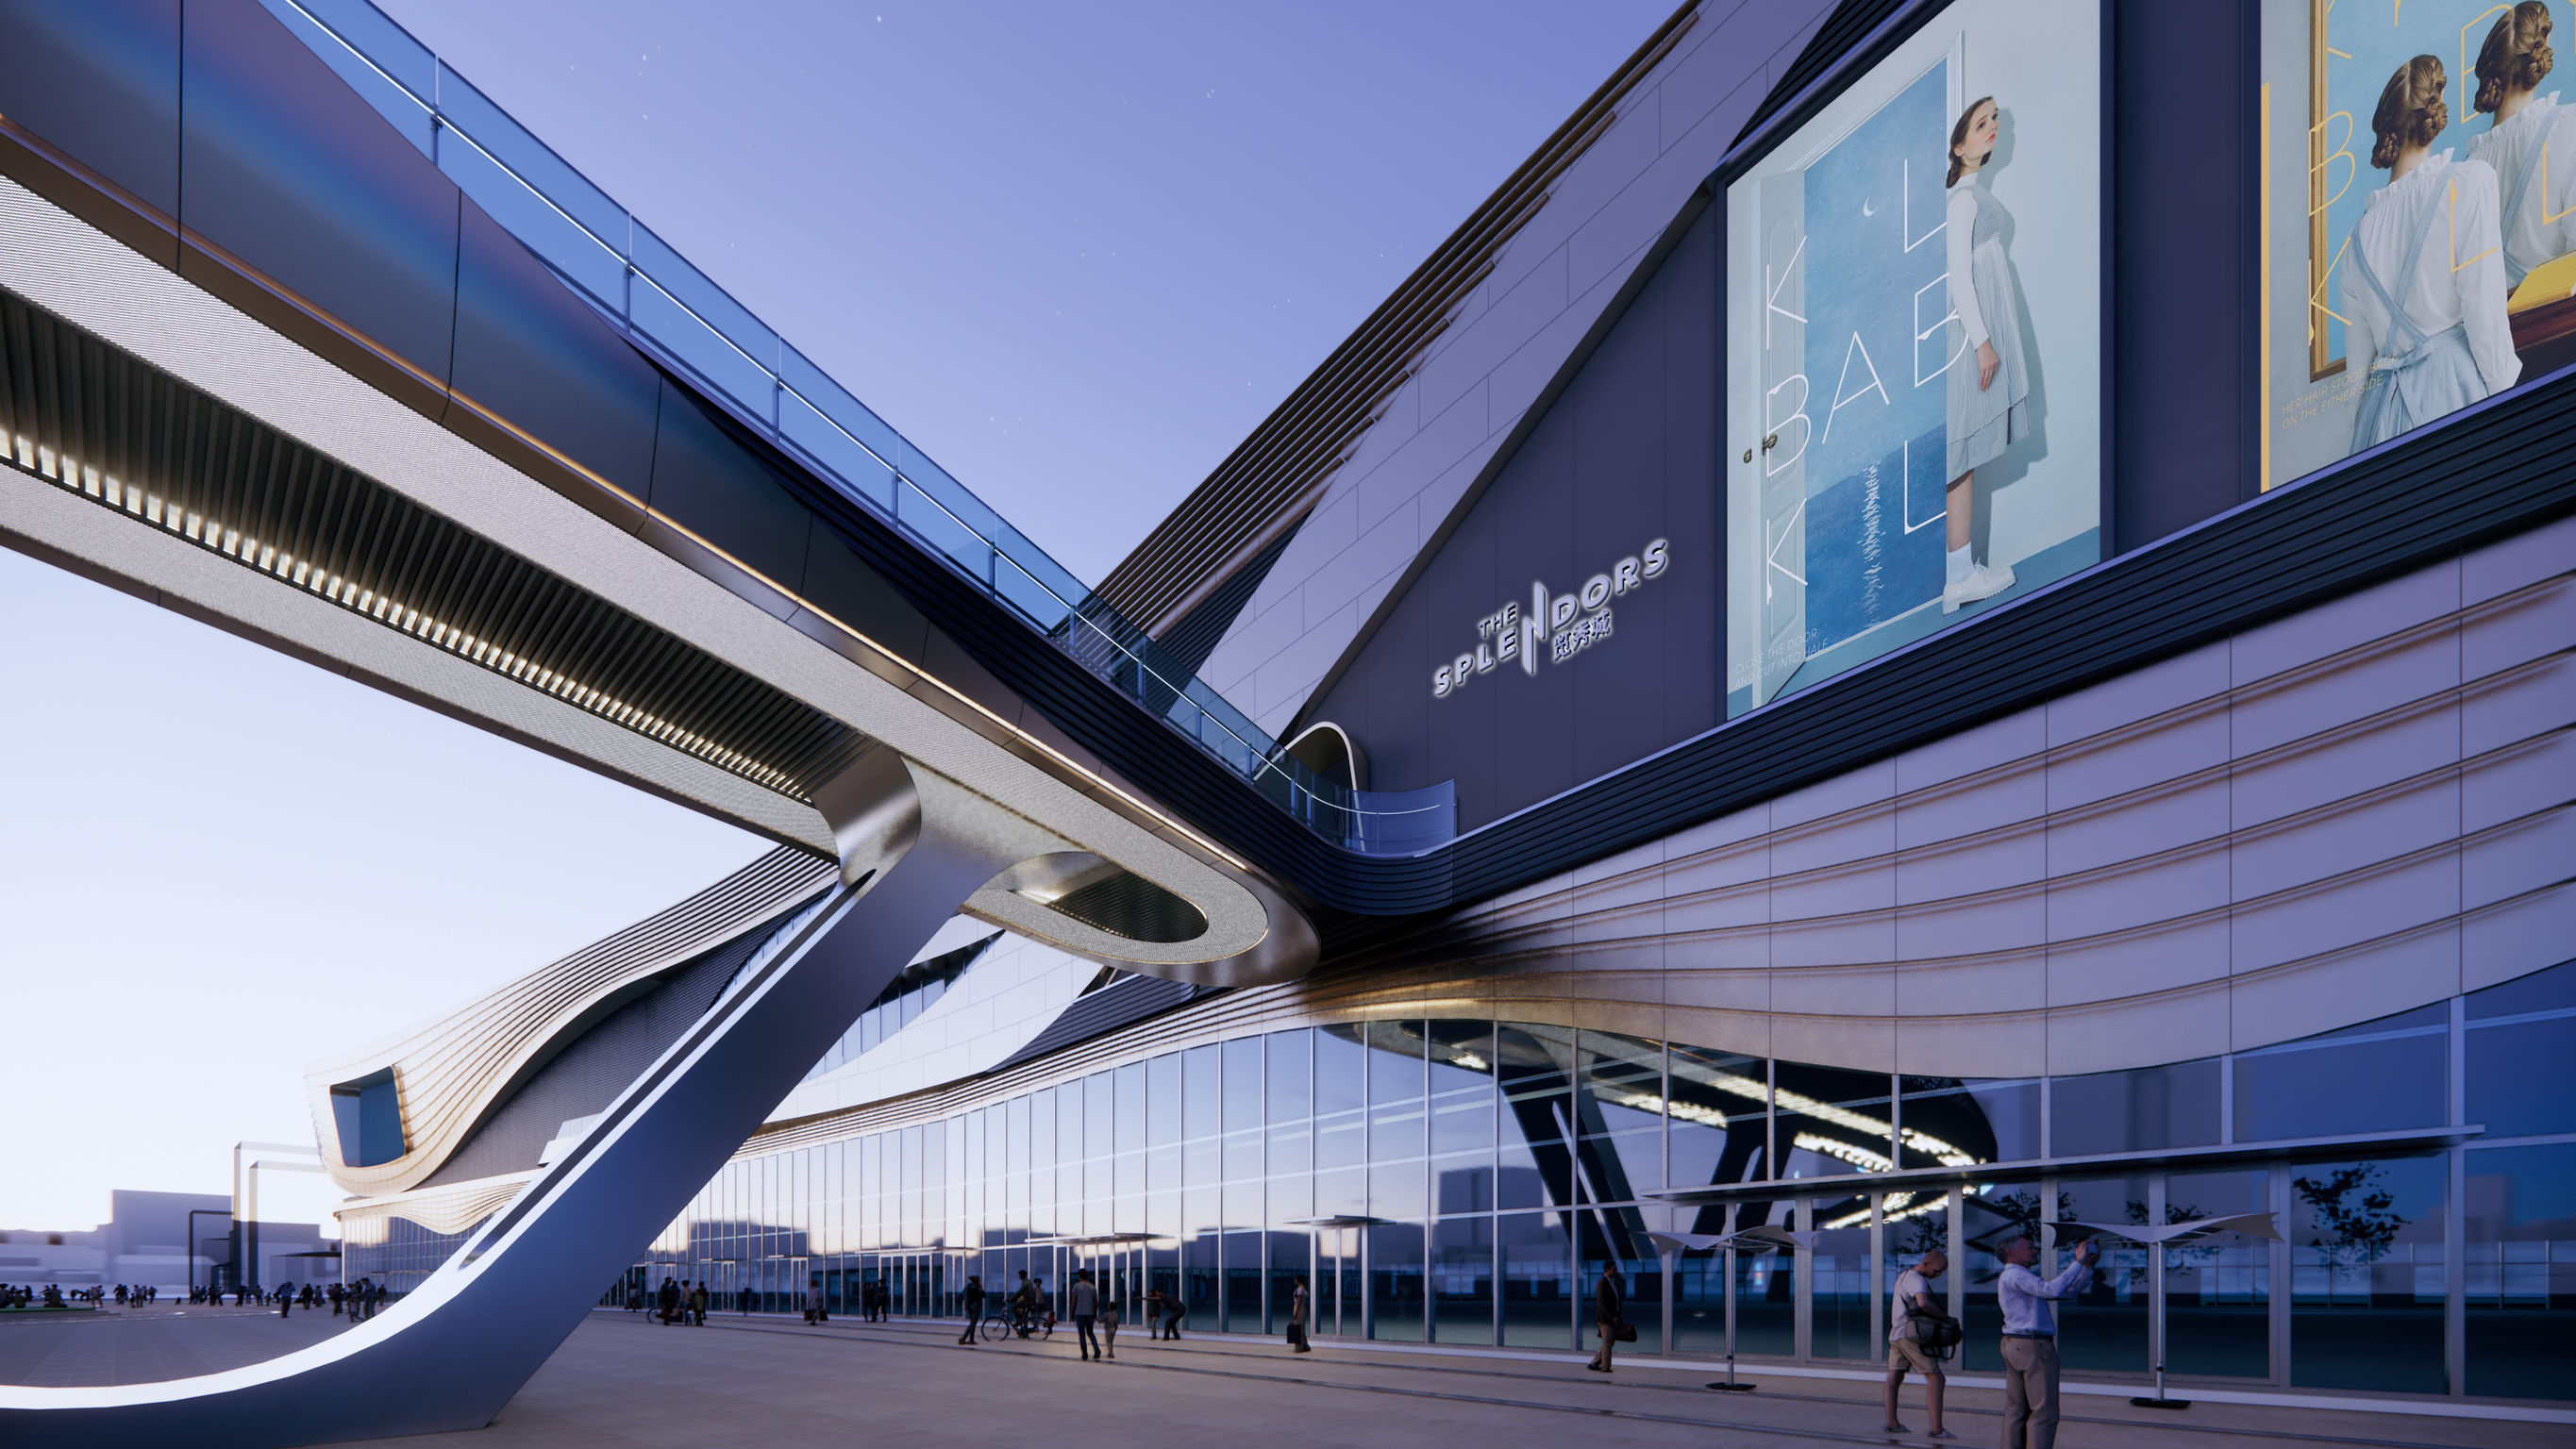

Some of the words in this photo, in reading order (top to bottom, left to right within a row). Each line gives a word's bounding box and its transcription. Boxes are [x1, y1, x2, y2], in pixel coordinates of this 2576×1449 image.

[2282, 415, 2298, 429] ON
[2300, 404, 2318, 422] THE
[2321, 386, 2357, 412] EITHER
[2360, 374, 2384, 395] SIDE
[2283, 398, 2301, 415] HER
[2304, 384, 2329, 405] HAIR
[2330, 367, 2367, 392] STOOD
[2369, 354, 2397, 375] BACK
[1433, 539, 1667, 696] SPLENDORS
[1479, 603, 1517, 639] THE
[1554, 609, 1612, 662] 览秀城
[1734, 653, 1765, 675] CLOSE
[1767, 643, 1785, 659] THE
[1787, 627, 1817, 651] DOOR
[1778, 651, 1801, 670] INTO
[1802, 637, 1829, 658] HALF
